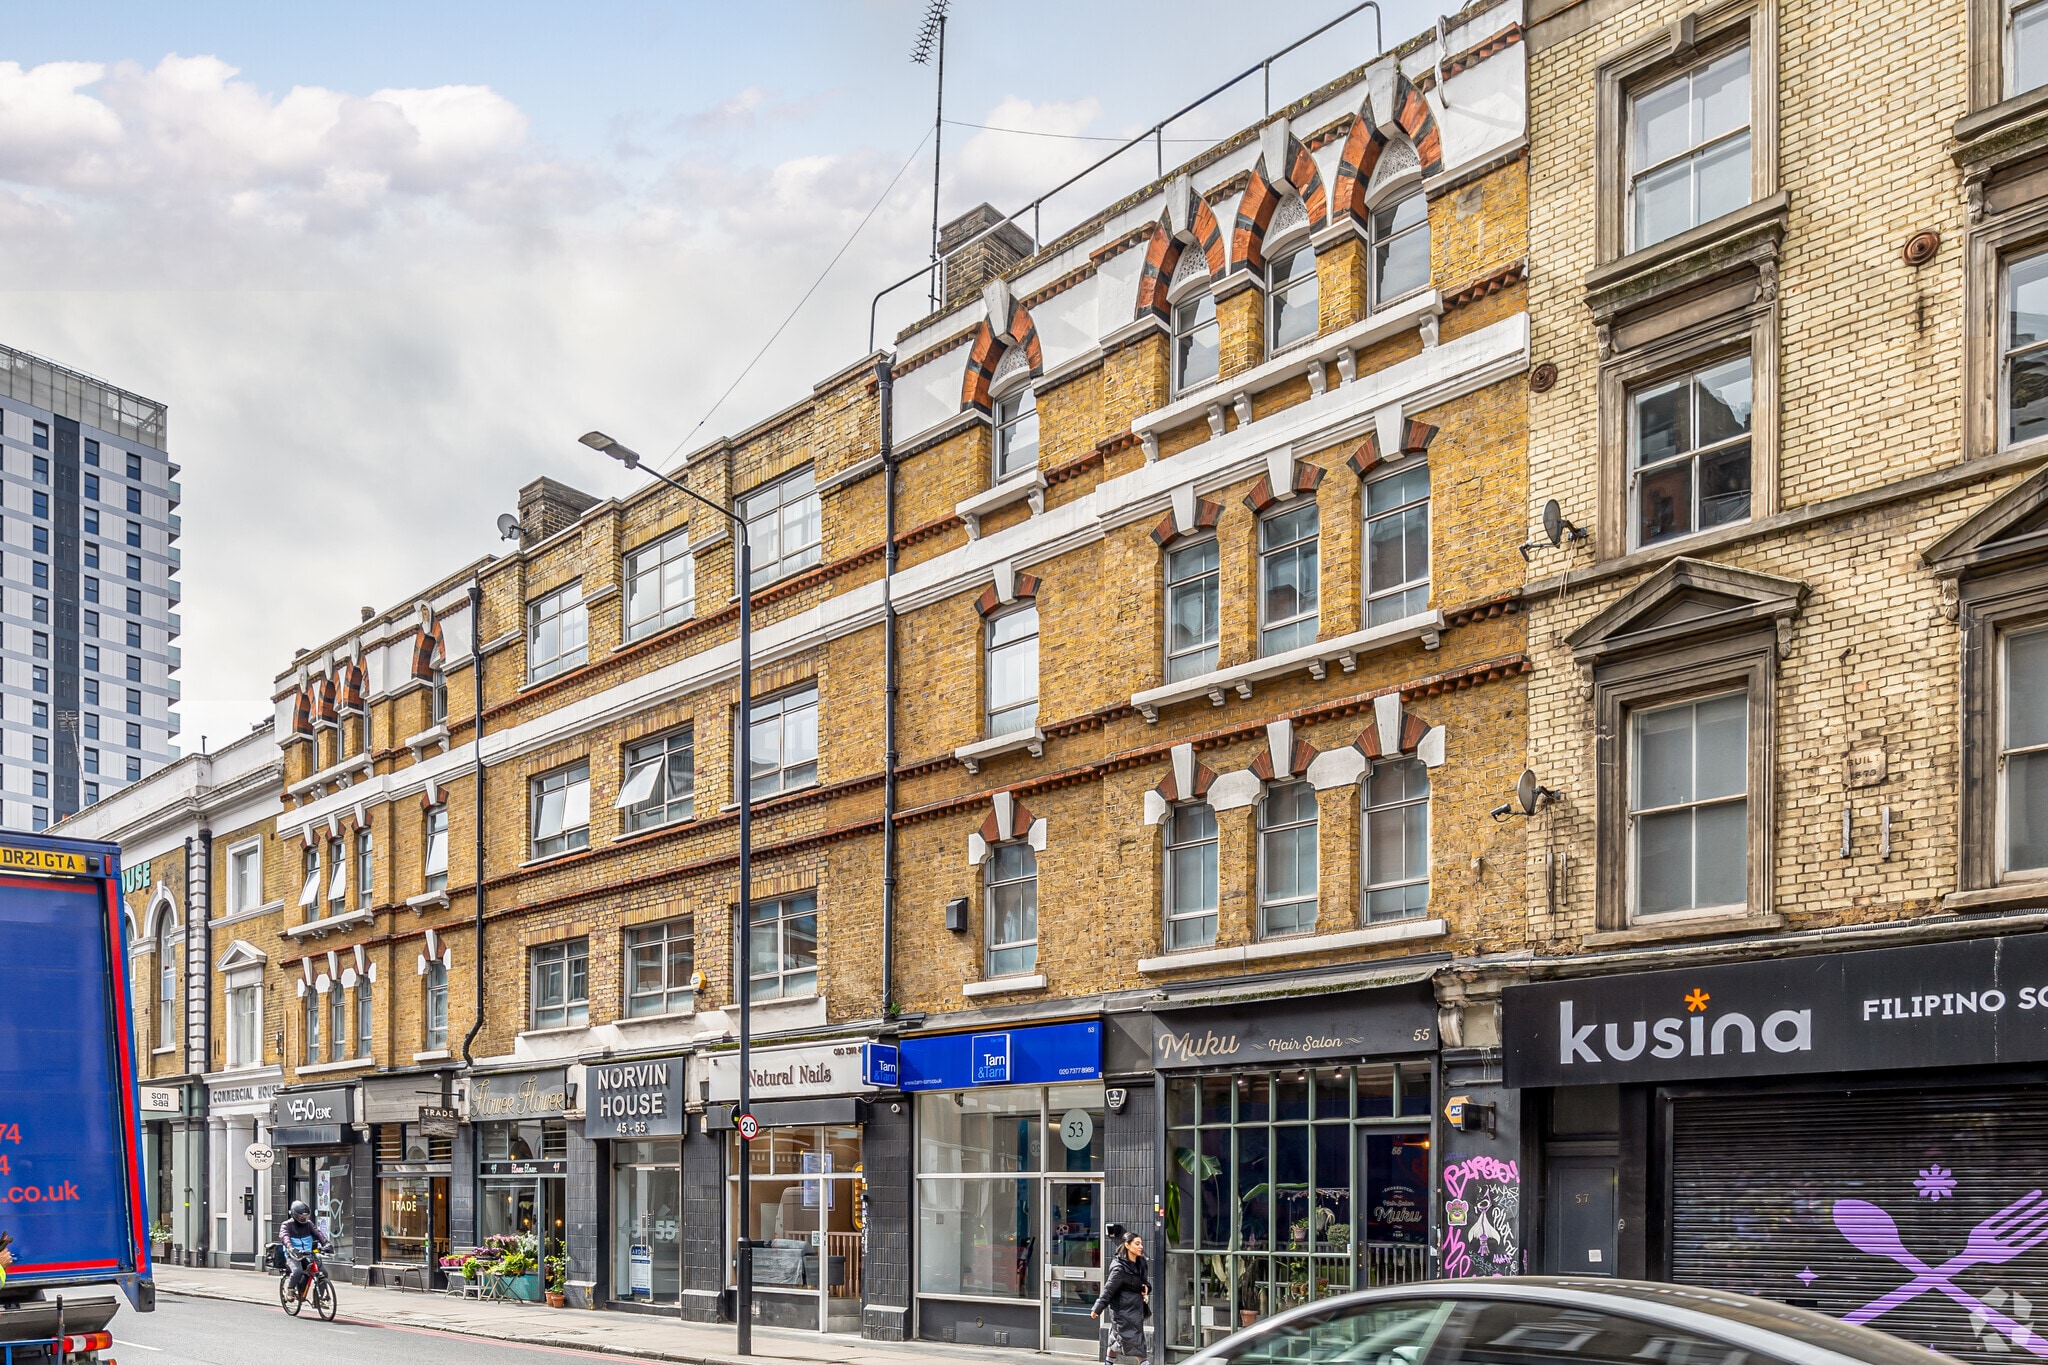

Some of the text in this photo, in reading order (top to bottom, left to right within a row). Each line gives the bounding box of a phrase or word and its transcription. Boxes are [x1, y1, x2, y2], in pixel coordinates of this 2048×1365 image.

[2, 849, 76, 870] DR21 GTA
[1863, 989, 2006, 1021] FILIPINO
[1560, 988, 1812, 1064] kusina
[1413, 1029, 1430, 1041] 55
[1158, 1030, 1343, 1061] Muku Hair Salon
[878, 1060, 896, 1072] Tarn
[983, 1053, 1005, 1066] Tarn
[598, 1064, 667, 1090] NORVIN
[749, 1062, 832, 1087] Natural Nails
[874, 1070, 896, 1082] &Tarn
[977, 1066, 1005, 1078] &Tarn
[600, 1093, 663, 1117] HOUSE
[1451, 1106, 1461, 1115] AD
[424, 1108, 454, 1118] TRADE
[616, 1123, 627, 1133] 45
[635, 1122, 646, 1132] 55
[742, 1121, 756, 1133] 20
[1068, 1121, 1084, 1137] 53
[1575, 1193, 1590, 1204] 57
[391, 1200, 417, 1212] TRADE
[1374, 1207, 1422, 1224] Muku
[655, 1220, 676, 1240] 55
